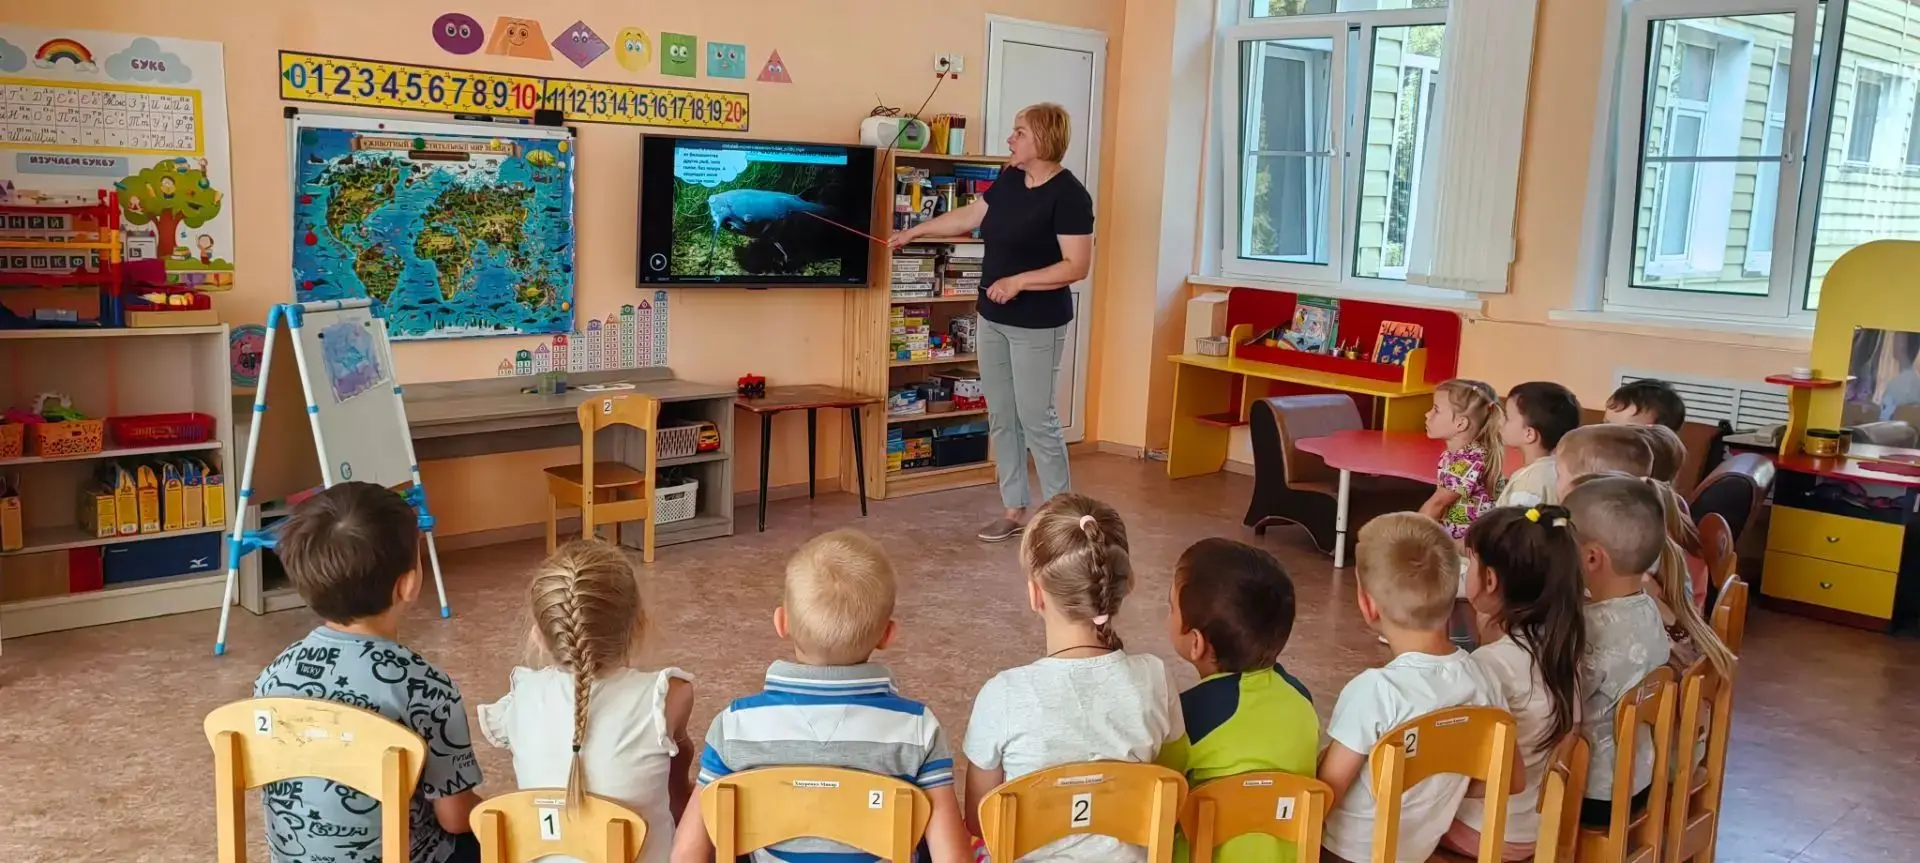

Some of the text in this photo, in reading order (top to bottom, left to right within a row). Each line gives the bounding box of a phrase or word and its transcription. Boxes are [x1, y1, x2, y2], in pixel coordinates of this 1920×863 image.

[290, 63, 537, 110] 0 1 2 3 4 5 6 7 8 9 10
[551, 88, 742, 123] 11 12 13 14 15 16 17 18 19 20
[30, 156, 115, 167] ИЗУЧАЕМ БУКВУ
[604, 402, 611, 412] 2
[258, 716, 268, 731] 2
[1405, 733, 1417, 753] 2
[872, 793, 880, 805] 2
[1074, 800, 1088, 822] 2
[1281, 806, 1287, 818] 1
[543, 814, 554, 835] 1
